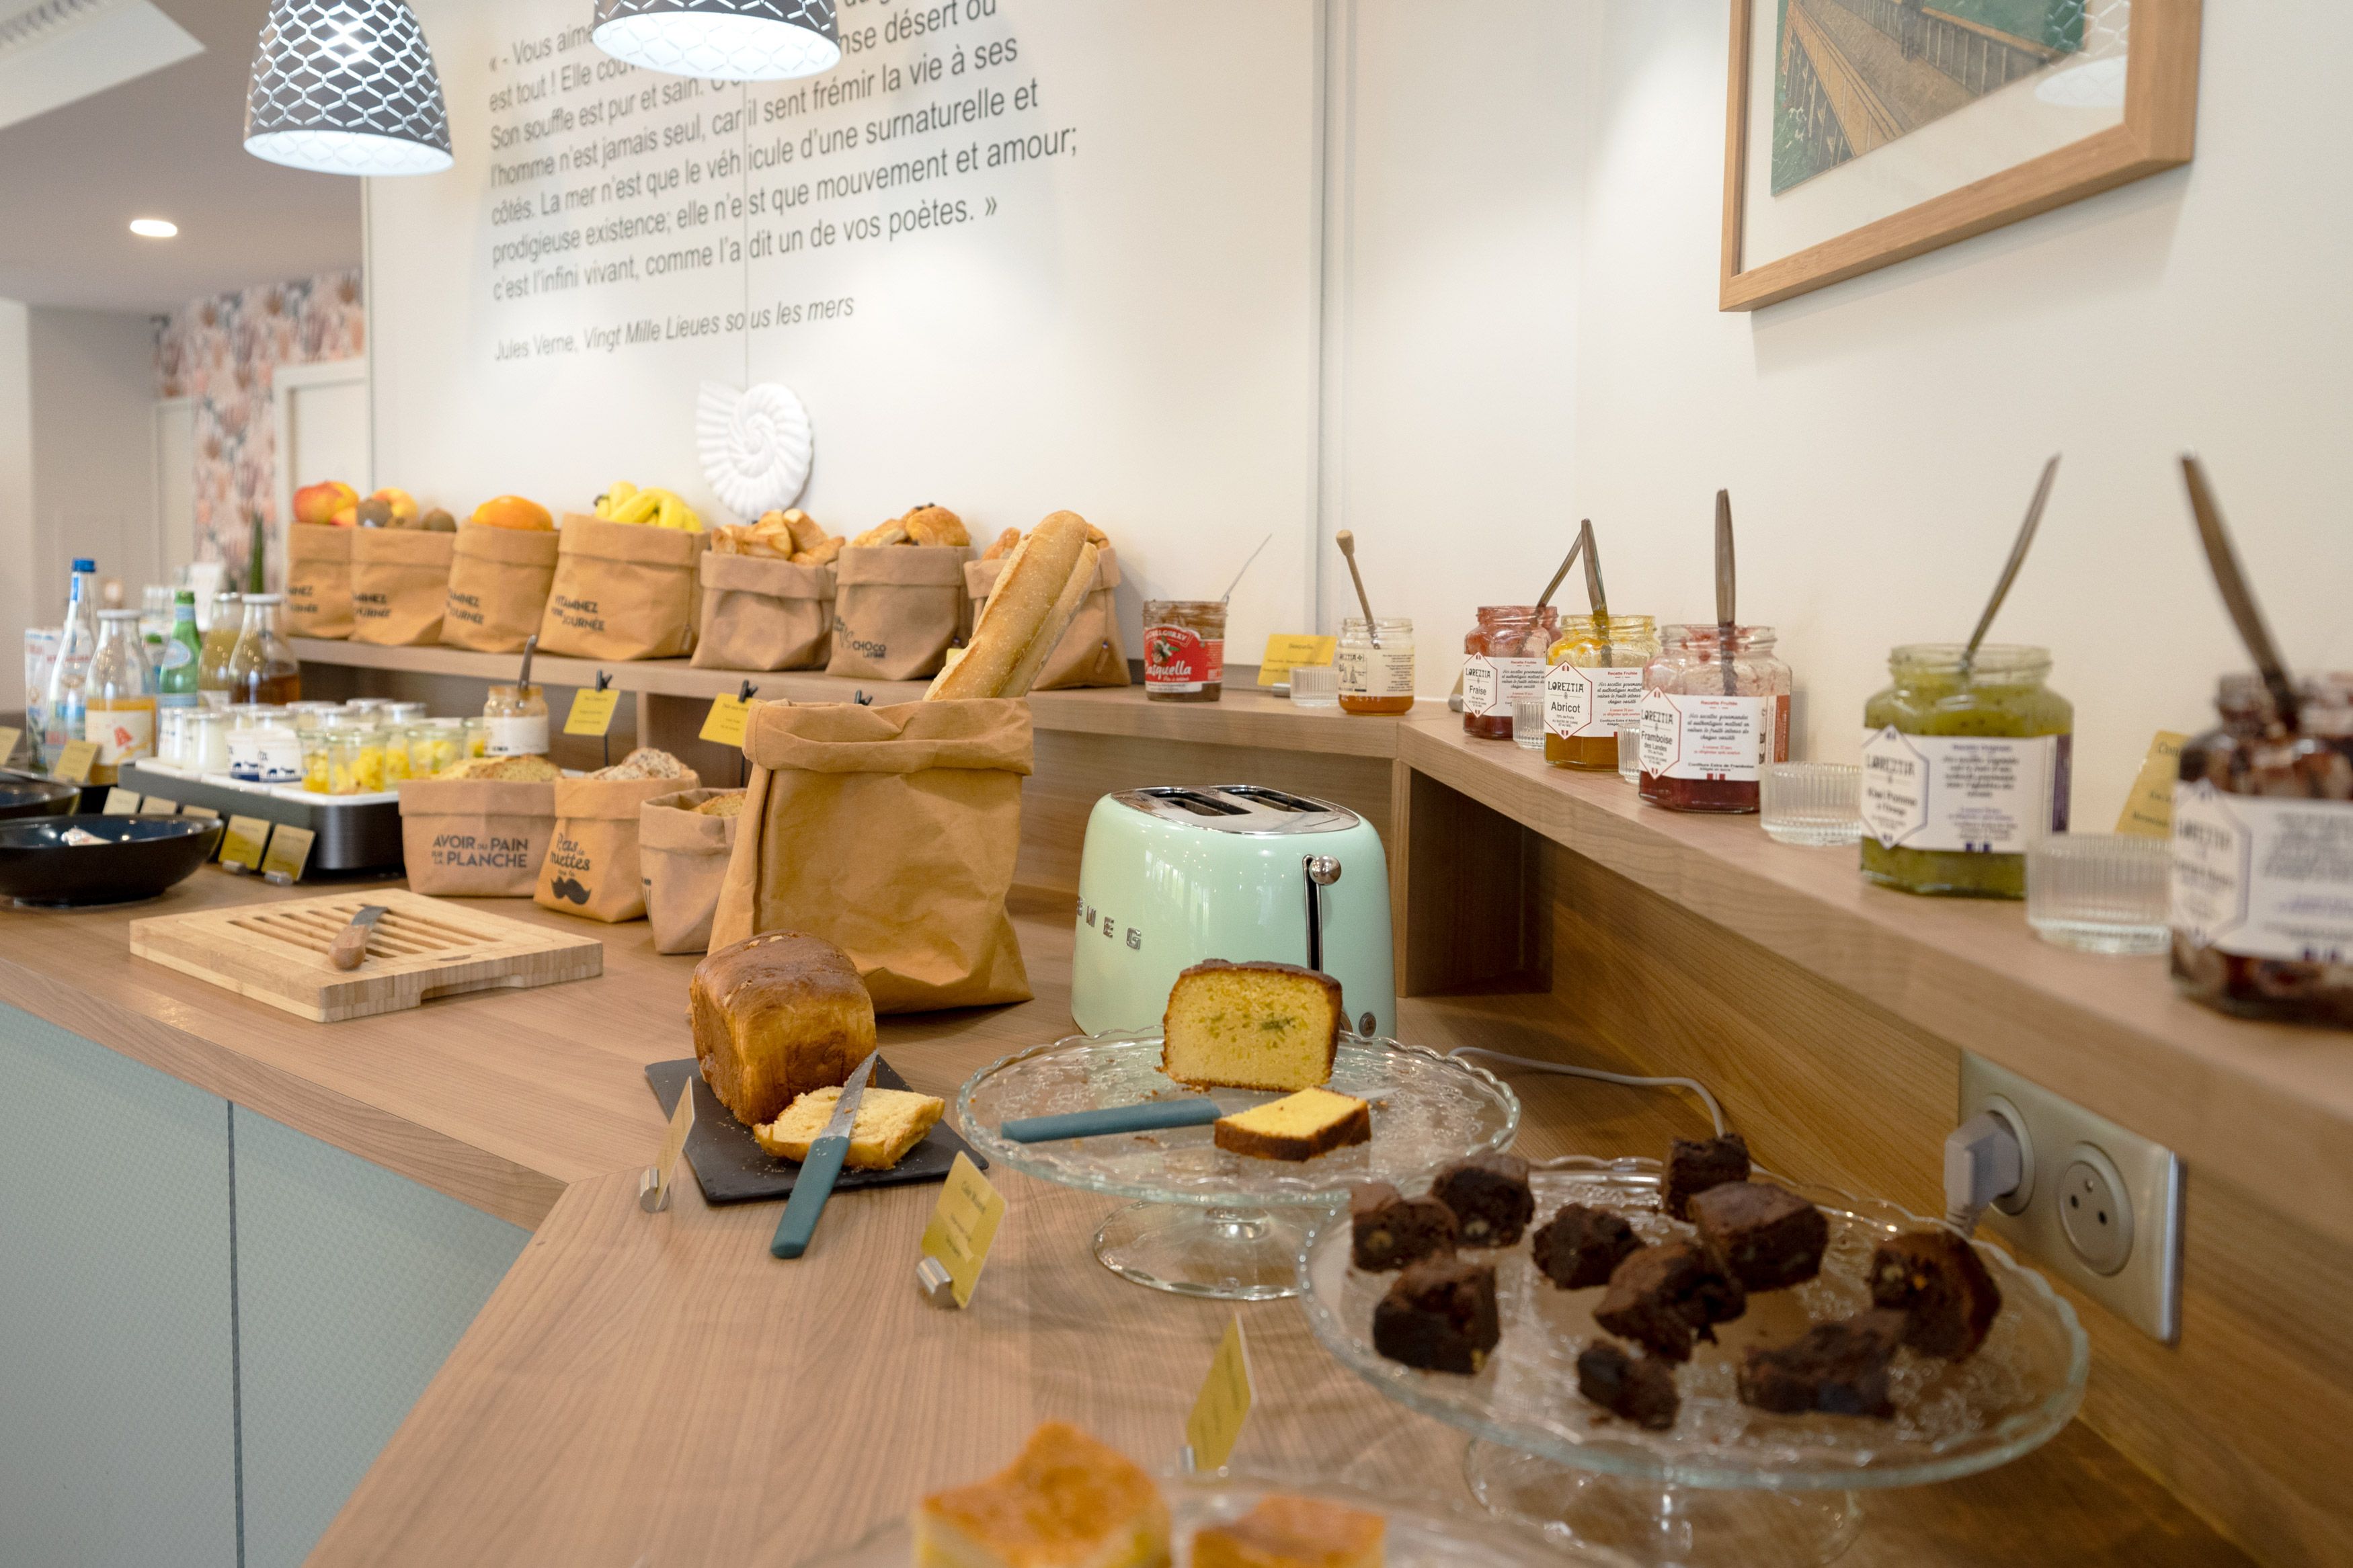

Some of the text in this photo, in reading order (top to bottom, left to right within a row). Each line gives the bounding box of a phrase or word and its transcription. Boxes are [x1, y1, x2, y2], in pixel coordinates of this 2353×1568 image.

[512, 35, 552, 65] Vous
[491, 124, 521, 151] Son
[524, 107, 573, 141] souffle
[580, 102, 604, 126] est
[608, 95, 636, 125] pur
[641, 83, 657, 111] et
[662, 77, 705, 104] sain.
[885, 0, 958, 43] désert
[489, 90, 513, 112] est
[517, 71, 547, 105] tout
[561, 60, 592, 91] Elle
[491, 36, 1018, 188] l'homme n'est jamais seul, car il sent frémir la vie à ses
[491, 200, 534, 226] côtés.
[541, 192, 561, 216] La
[565, 188, 596, 210] mer
[601, 177, 642, 202] n'est
[647, 169, 679, 198] que
[685, 159, 701, 184] le
[801, 124, 858, 159] d'une
[866, 87, 1004, 145] surnaturelle
[1014, 77, 1038, 110] et
[493, 229, 580, 268] prodigieuse
[677, 202, 709, 228] elle
[772, 183, 809, 214] que
[817, 148, 949, 202] mouvement
[957, 142, 978, 173] et
[987, 127, 1078, 167] amour;
[493, 276, 529, 300] c'est
[534, 265, 579, 294] l'infini
[585, 256, 639, 284] vivant,
[645, 245, 713, 276] comme
[720, 235, 741, 263] l'a
[749, 230, 772, 259] dit
[779, 229, 803, 253] un
[811, 220, 836, 248] de
[843, 215, 881, 241] vos
[889, 199, 975, 241] poètes.
[495, 337, 528, 362] Jules
[534, 333, 579, 355] Verne,
[584, 327, 621, 353] Vingt
[625, 319, 660, 343] Mille
[666, 315, 720, 340] Lieues
[776, 301, 802, 326] les
[807, 296, 854, 320] mers
[1466, 667, 1490, 678] LOREZTIA
[1469, 685, 1486, 695] Fraise
[1548, 681, 1584, 693] LOREZTIA
[1551, 701, 1581, 713] Abricot
[1641, 709, 1673, 725] LOREZTIA
[1641, 731, 1673, 745] Framboise
[433, 835, 475, 850] AVOIR
[490, 837, 528, 852] PAIN
[446, 851, 527, 868] PLANCHE
[550, 852, 591, 871] miettes
